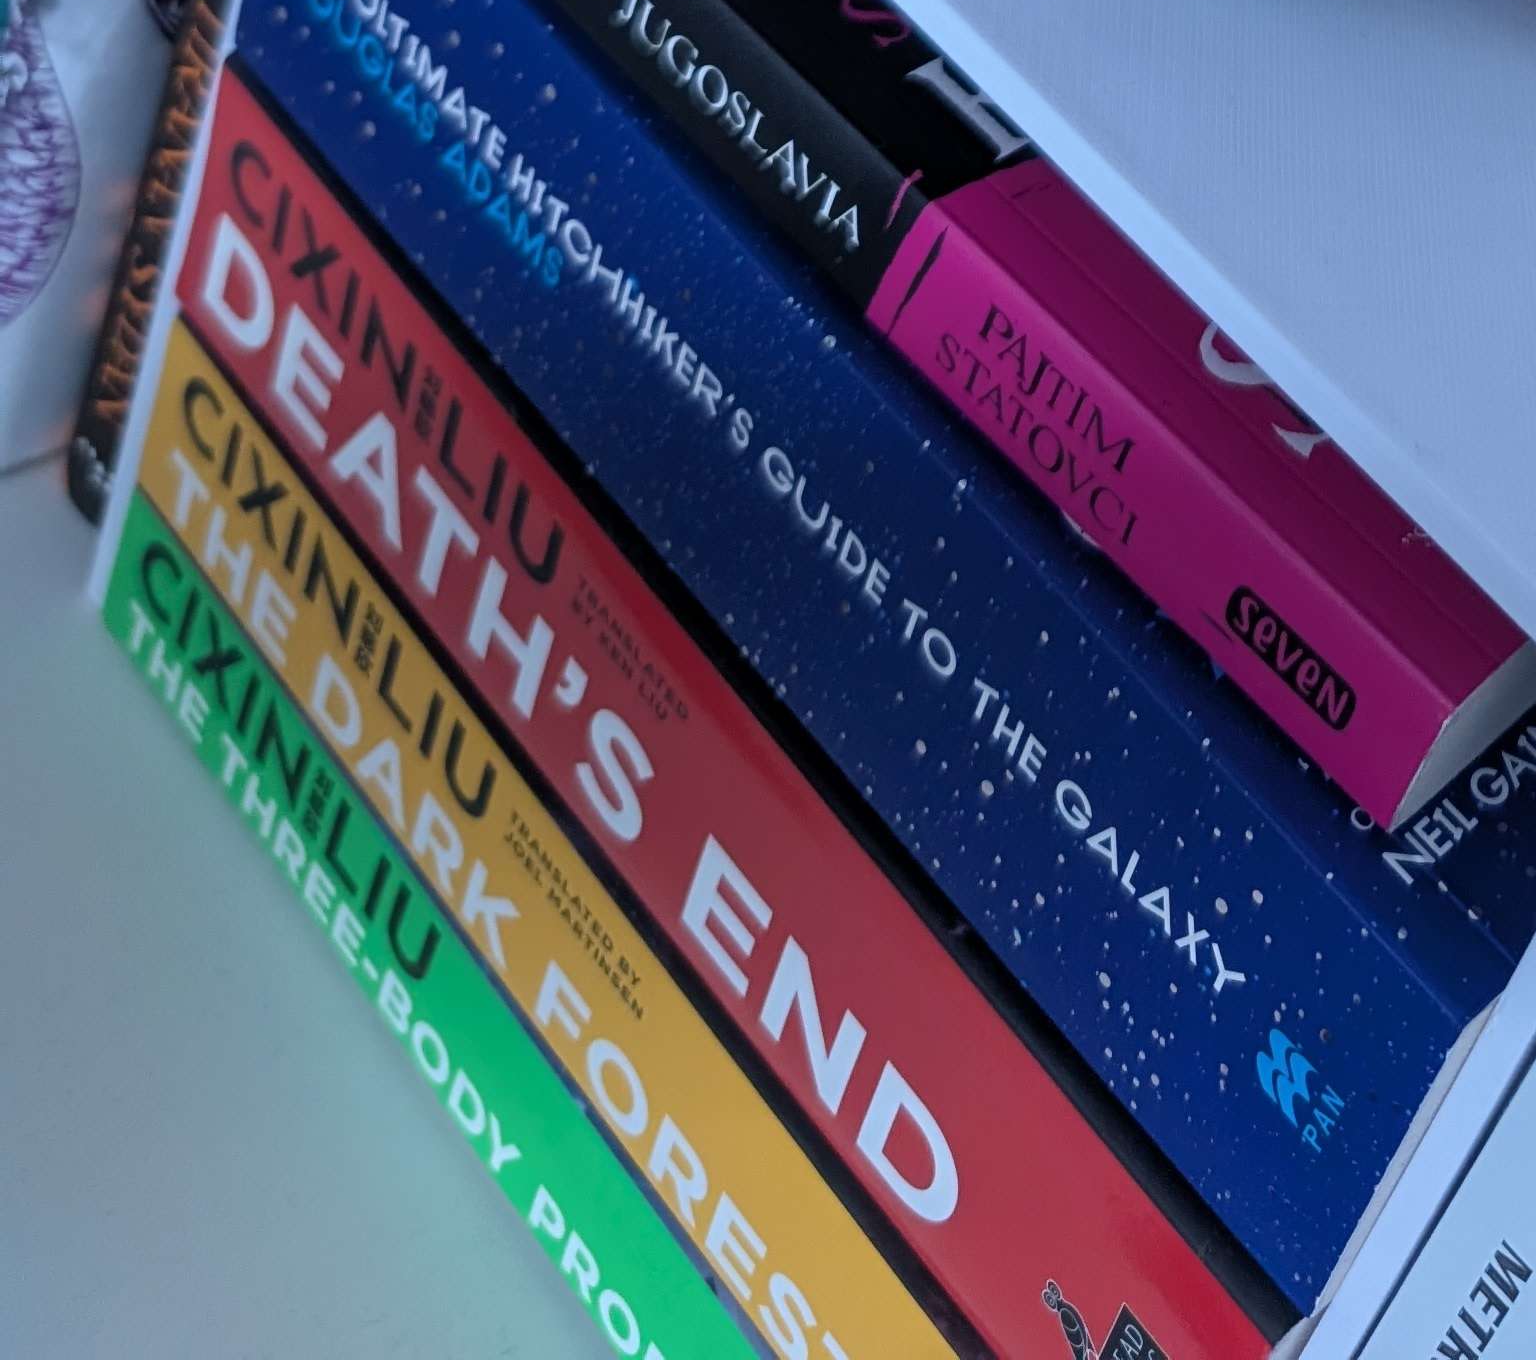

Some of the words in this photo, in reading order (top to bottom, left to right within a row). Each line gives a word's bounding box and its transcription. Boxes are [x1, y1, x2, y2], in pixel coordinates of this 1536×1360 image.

[440, 139, 564, 287] ADAMS
[230, 141, 416, 415] CIXIN
[436, 395, 566, 587] LIU
[936, 333, 1138, 547] STATOVCI
[979, 303, 1135, 473] PAJTIM
[182, 375, 360, 650] CIXIN
[377, 633, 500, 818] LIU
[504, 152, 752, 448] HITCHHIKER'S
[760, 446, 892, 601] GUIDE
[901, 598, 958, 677] TO
[971, 678, 1047, 783] THE
[1055, 780, 1246, 993] GALAXY
[141, 540, 314, 808] CIXIN
[323, 799, 442, 980] LIU
[162, 447, 297, 667] THE
[310, 653, 522, 971] DARK
[201, 211, 654, 842] DEATH'S
[681, 833, 960, 1224] END
[128, 597, 210, 744] THE
[217, 732, 521, 1175] THREE-BODY
[510, 810, 615, 954] TRANSLATED
[618, 954, 642, 987] BY
[1382, 797, 1479, 885] NEIL
[547, 886, 645, 1022] MARTINSEN
[1301, 1091, 1347, 1154] PAN
[1431, 1238, 1534, 1360] METR
